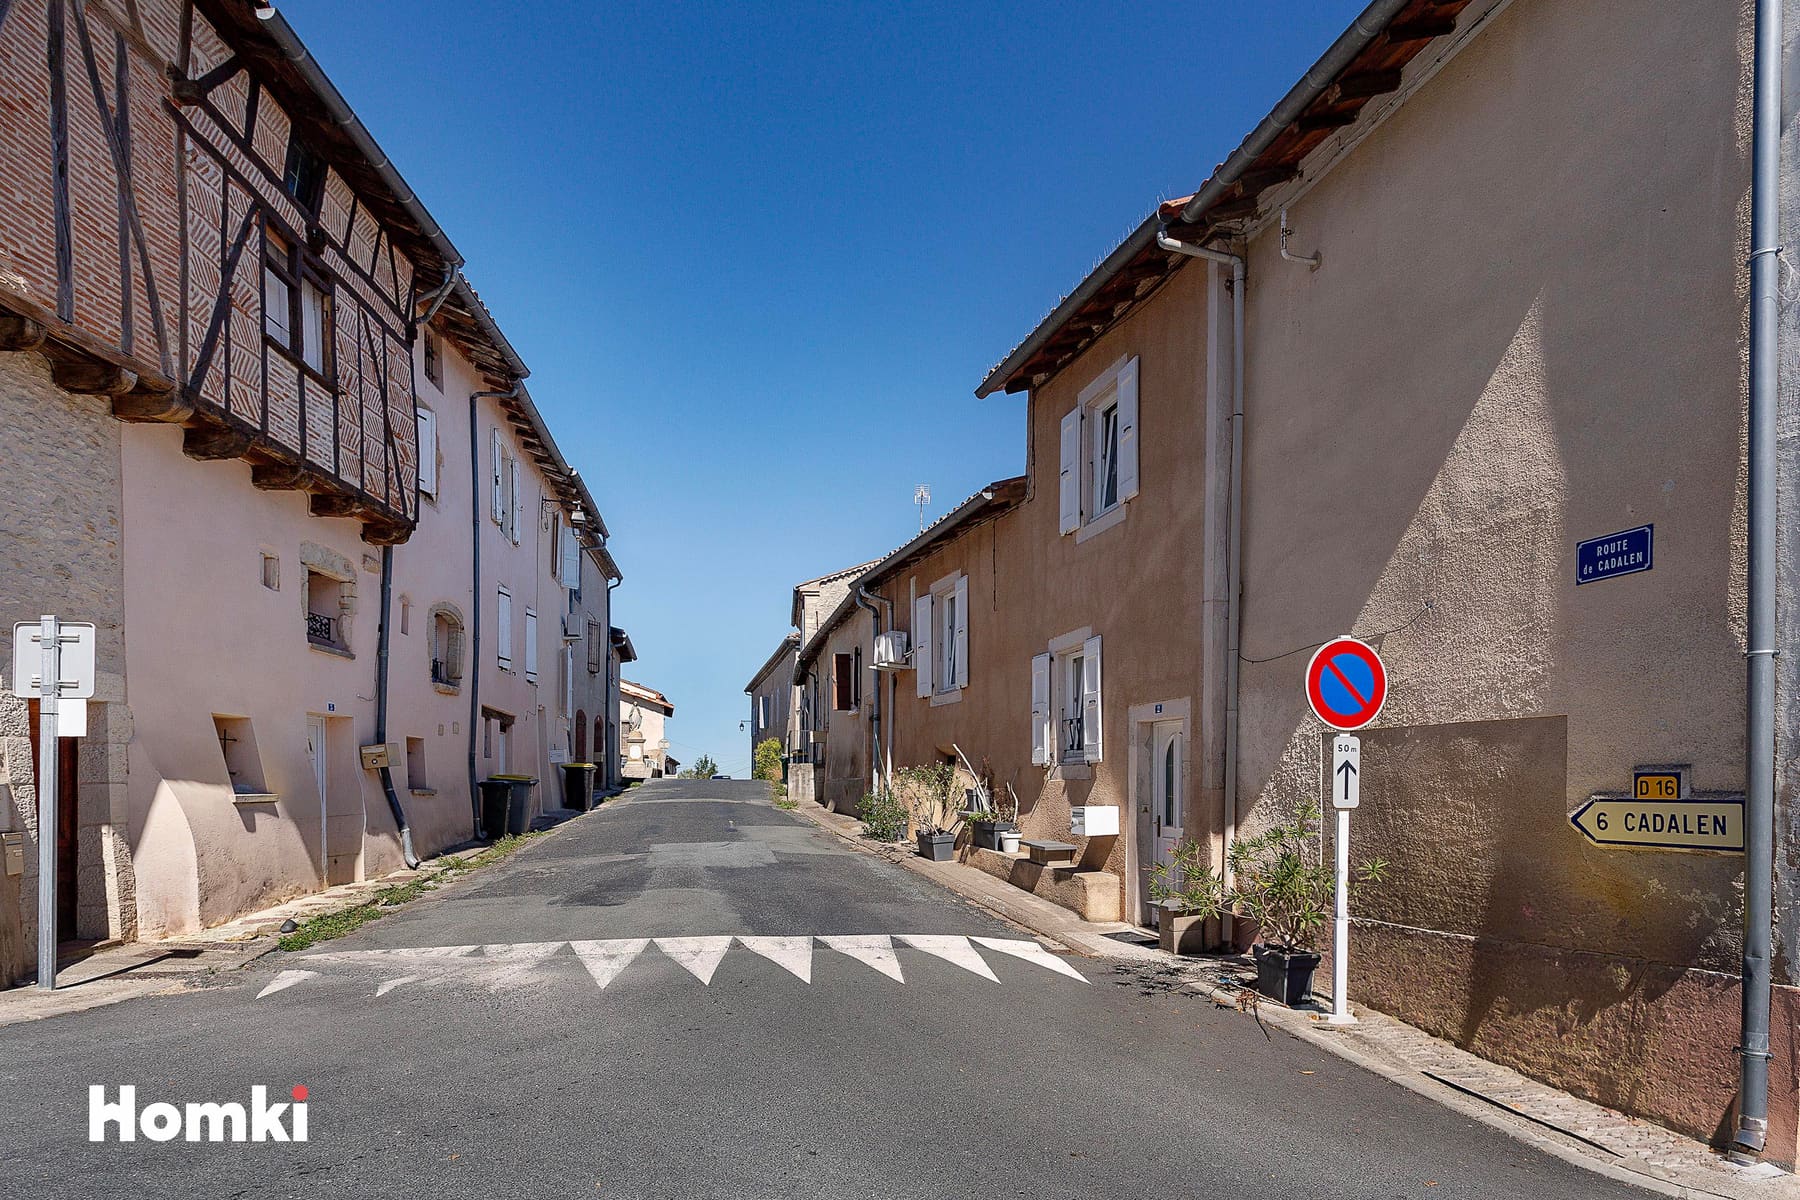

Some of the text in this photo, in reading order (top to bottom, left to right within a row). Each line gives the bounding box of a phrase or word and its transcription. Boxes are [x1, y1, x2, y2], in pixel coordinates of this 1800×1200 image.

[1597, 540, 1628, 557] ROUTE
[1583, 552, 1643, 575] de CADALEN
[1639, 780, 1675, 796] D 16
[1596, 812, 1727, 836] 6 CADALEN
